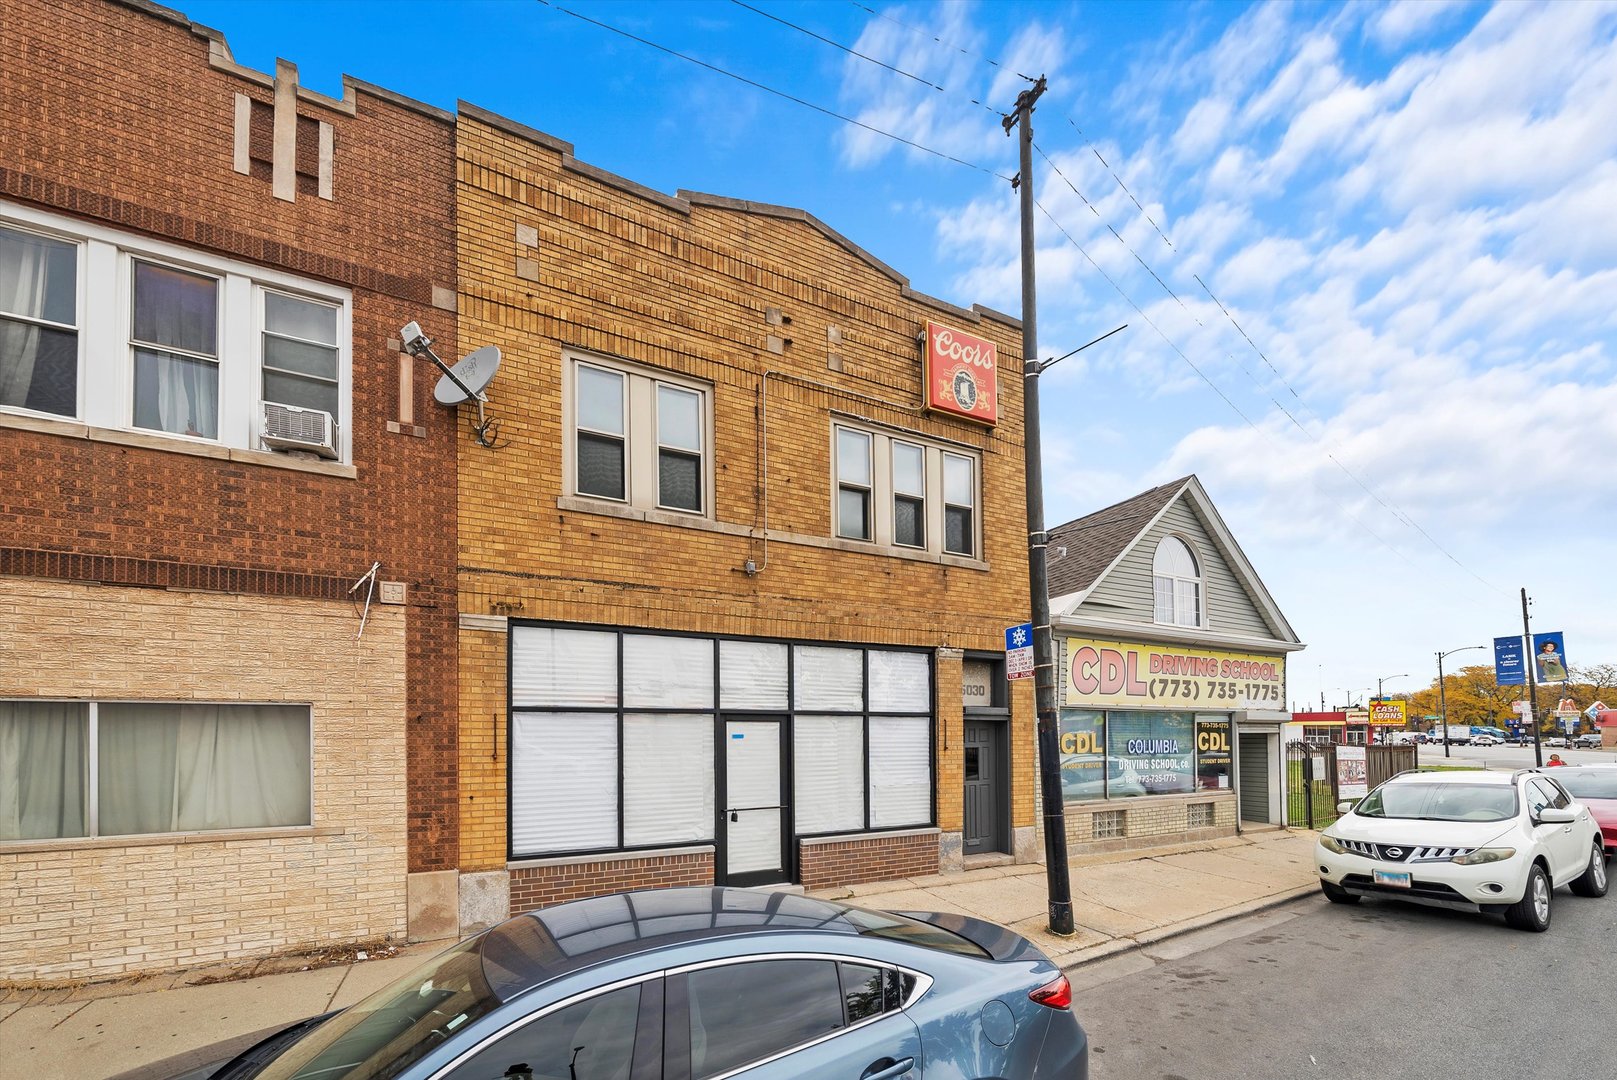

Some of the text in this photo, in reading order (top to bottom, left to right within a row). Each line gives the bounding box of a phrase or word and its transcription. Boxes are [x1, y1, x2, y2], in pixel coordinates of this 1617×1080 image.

[933, 330, 993, 370] Coors
[1071, 646, 1279, 696] CDL DRIVING SCHOOL
[1149, 678, 1279, 701] (773) 735-1775
[1060, 731, 1103, 754] CDL
[1128, 739, 1179, 754] COLUMBIA
[1198, 731, 1231, 751] CDL
[1118, 759, 1149, 770] DRIVING
